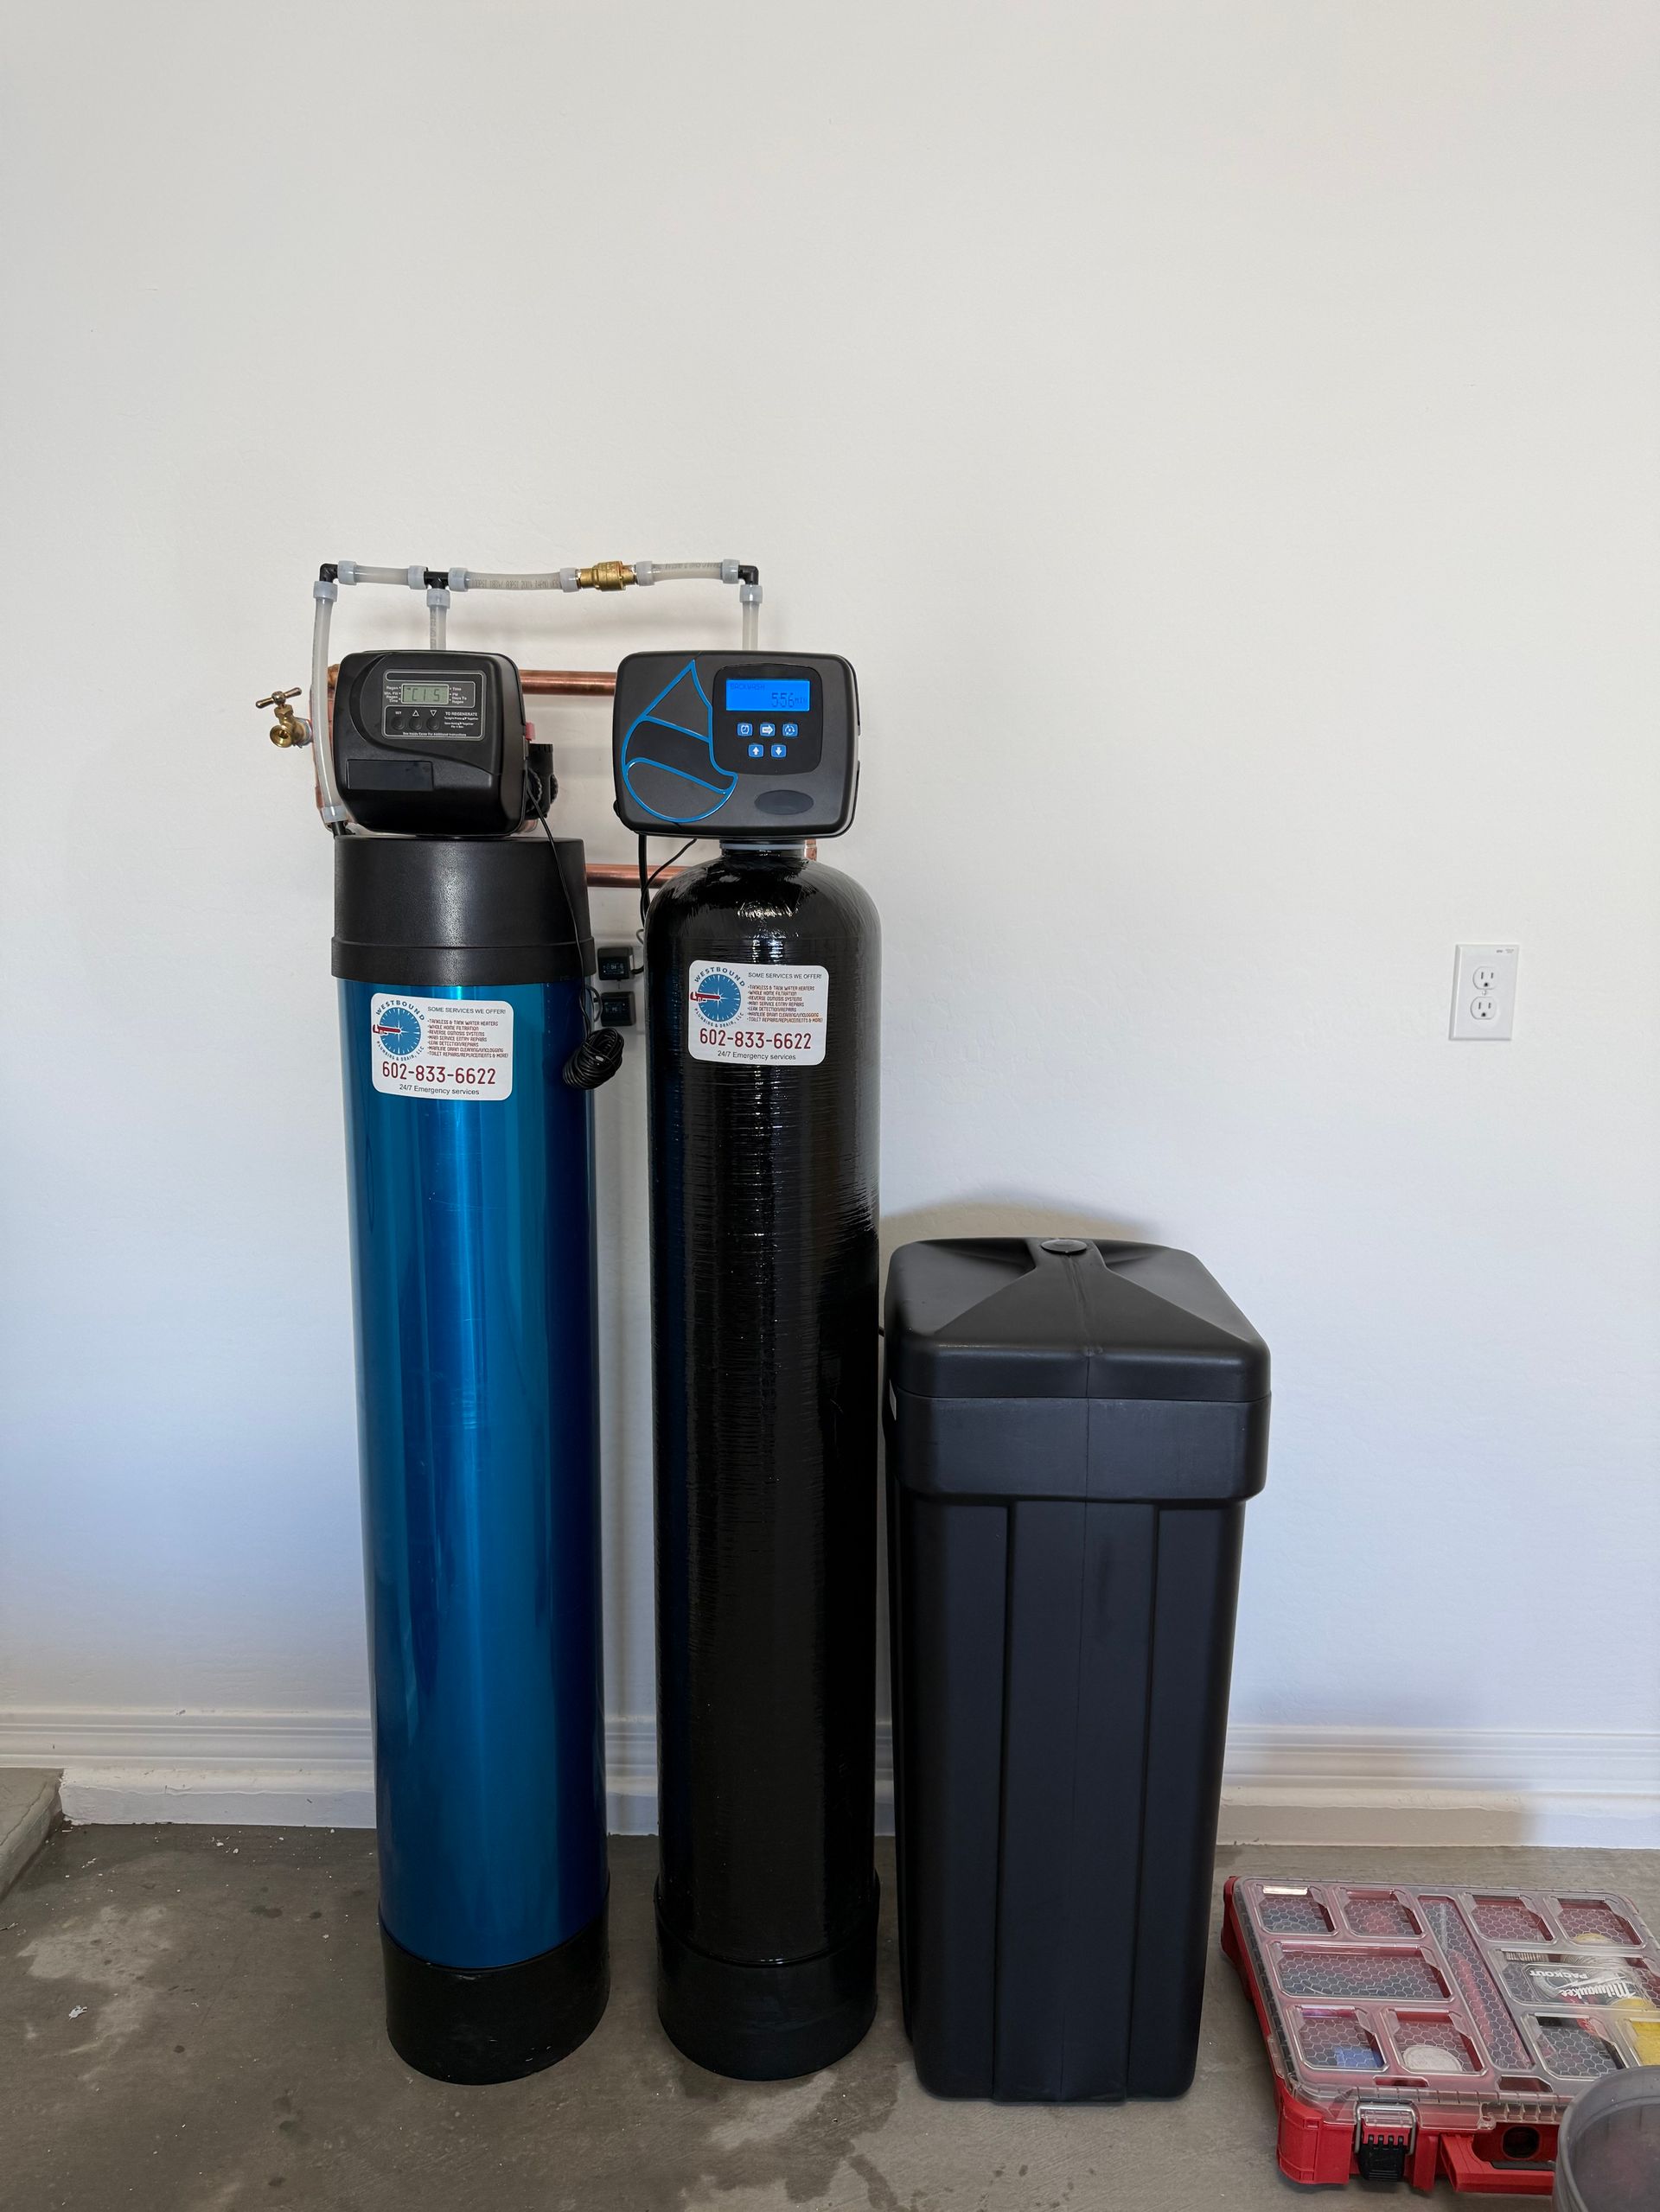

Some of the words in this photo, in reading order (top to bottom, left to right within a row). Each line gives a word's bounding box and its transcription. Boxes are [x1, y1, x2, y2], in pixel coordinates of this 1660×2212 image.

[694, 966, 745, 986] WESTBOUND
[376, 1000, 425, 1021] WESTBOUND
[700, 1029, 811, 1049] 602-833-6622
[383, 1061, 495, 1084] 602-833-6622
[414, 1087, 450, 1095] Emergency
[1529, 1970, 1588, 1979] PACKOUT
[1558, 1981, 1635, 1998] Milwaukee
